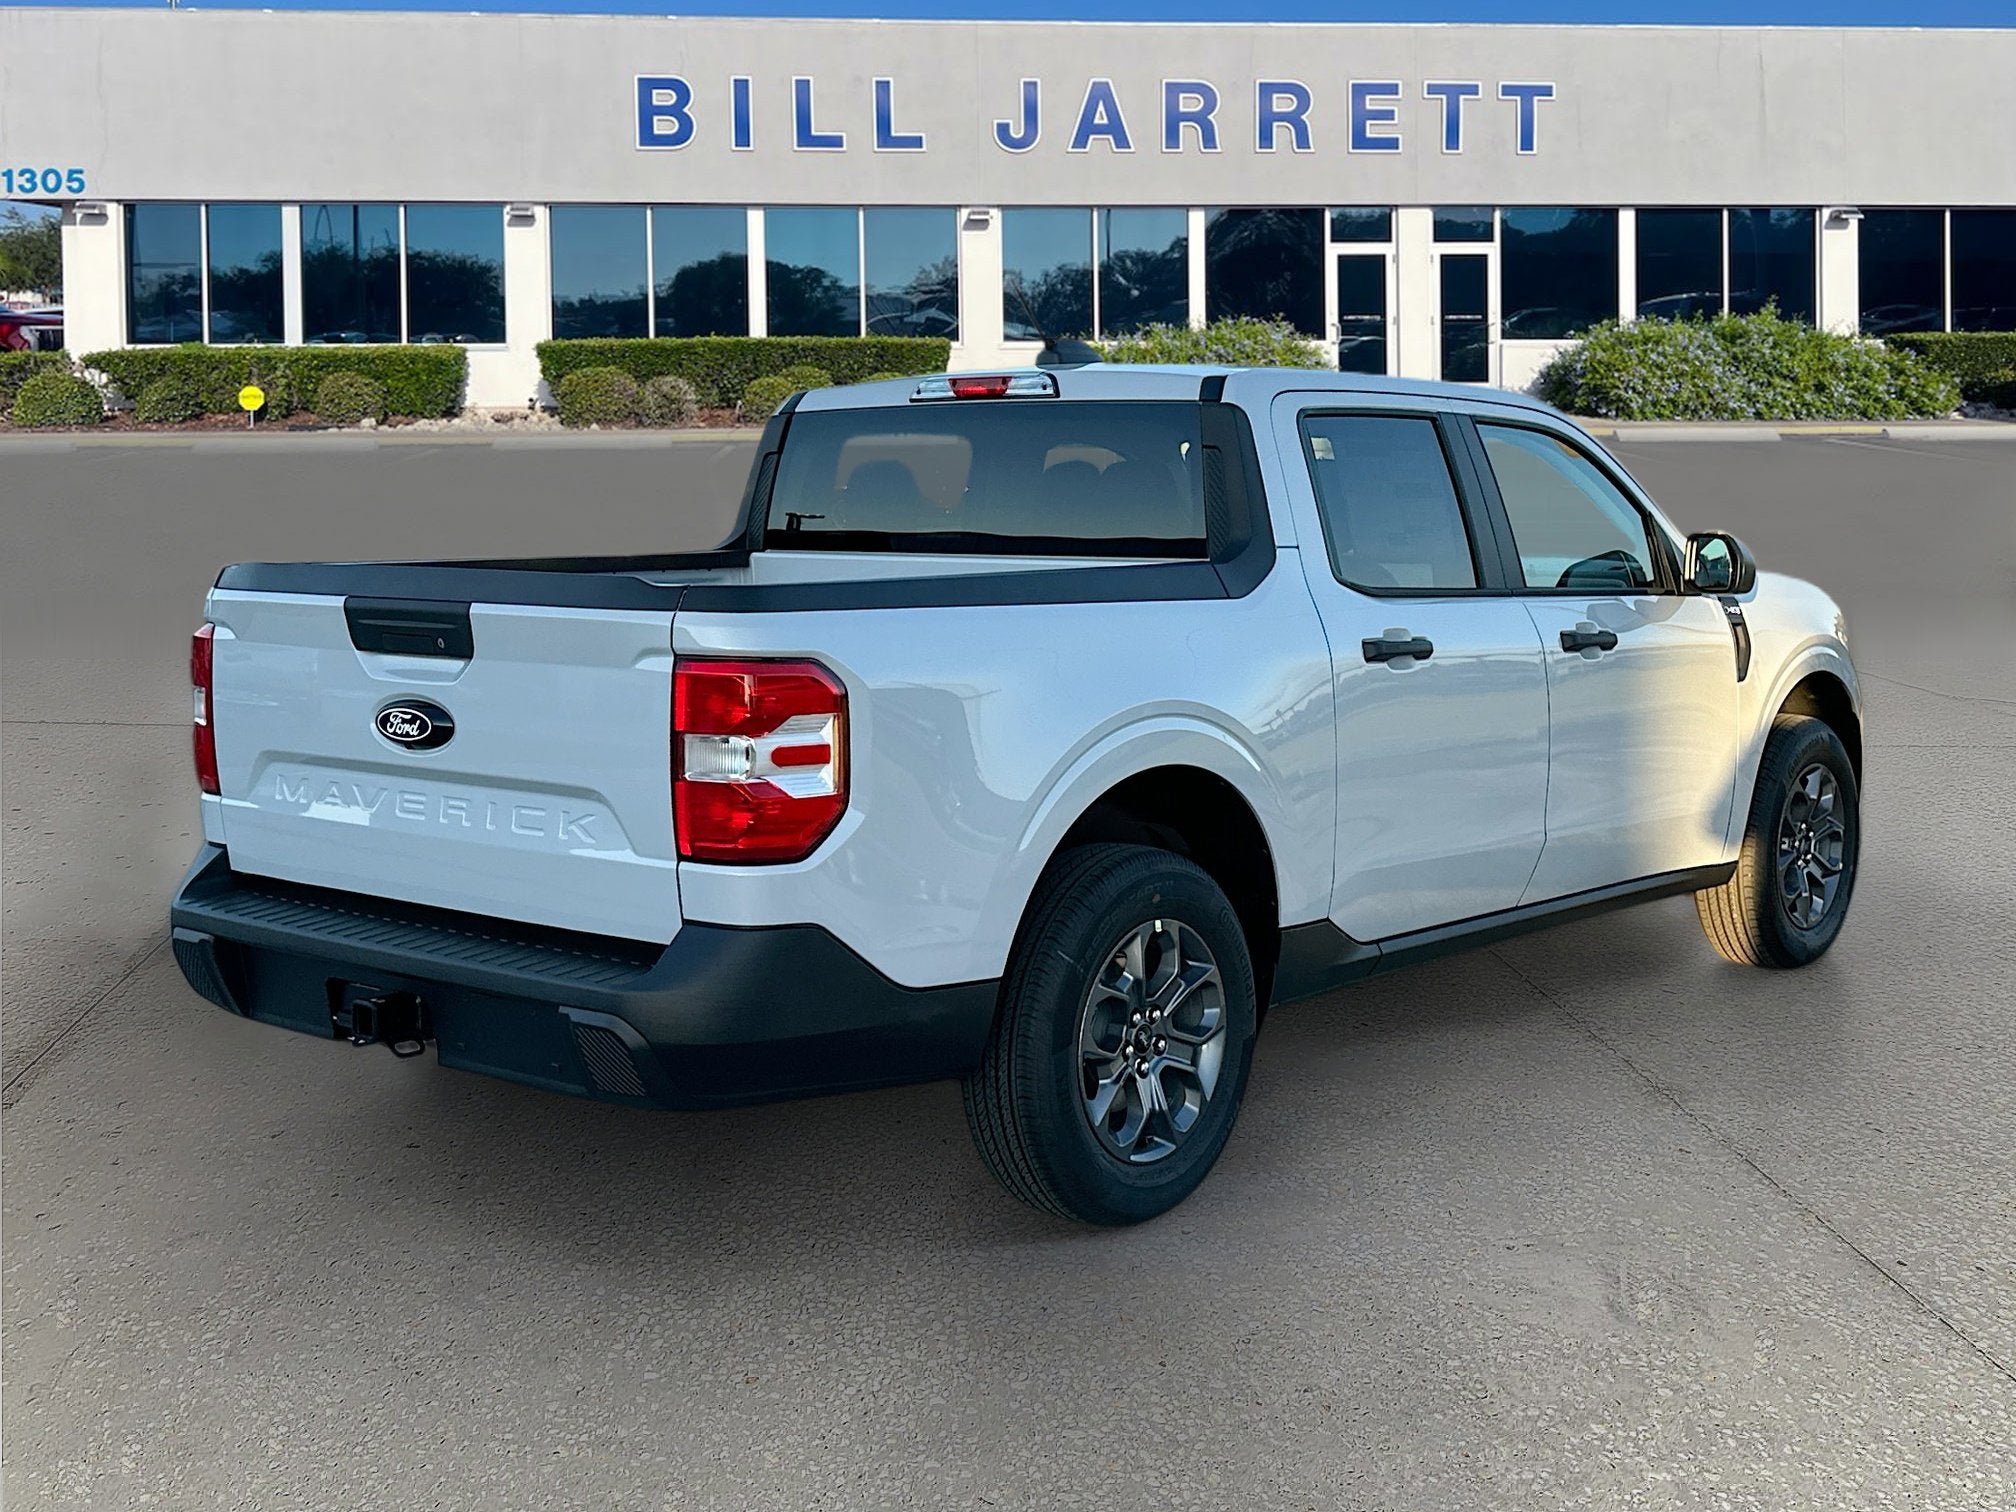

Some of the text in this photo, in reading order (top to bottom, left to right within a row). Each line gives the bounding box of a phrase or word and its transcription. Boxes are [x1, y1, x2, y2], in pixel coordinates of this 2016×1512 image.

[634, 75, 1557, 156] BILL JARRETT
[1, 167, 86, 194] 1305
[386, 711, 421, 736] Ford
[274, 774, 597, 844] MAVERICK
